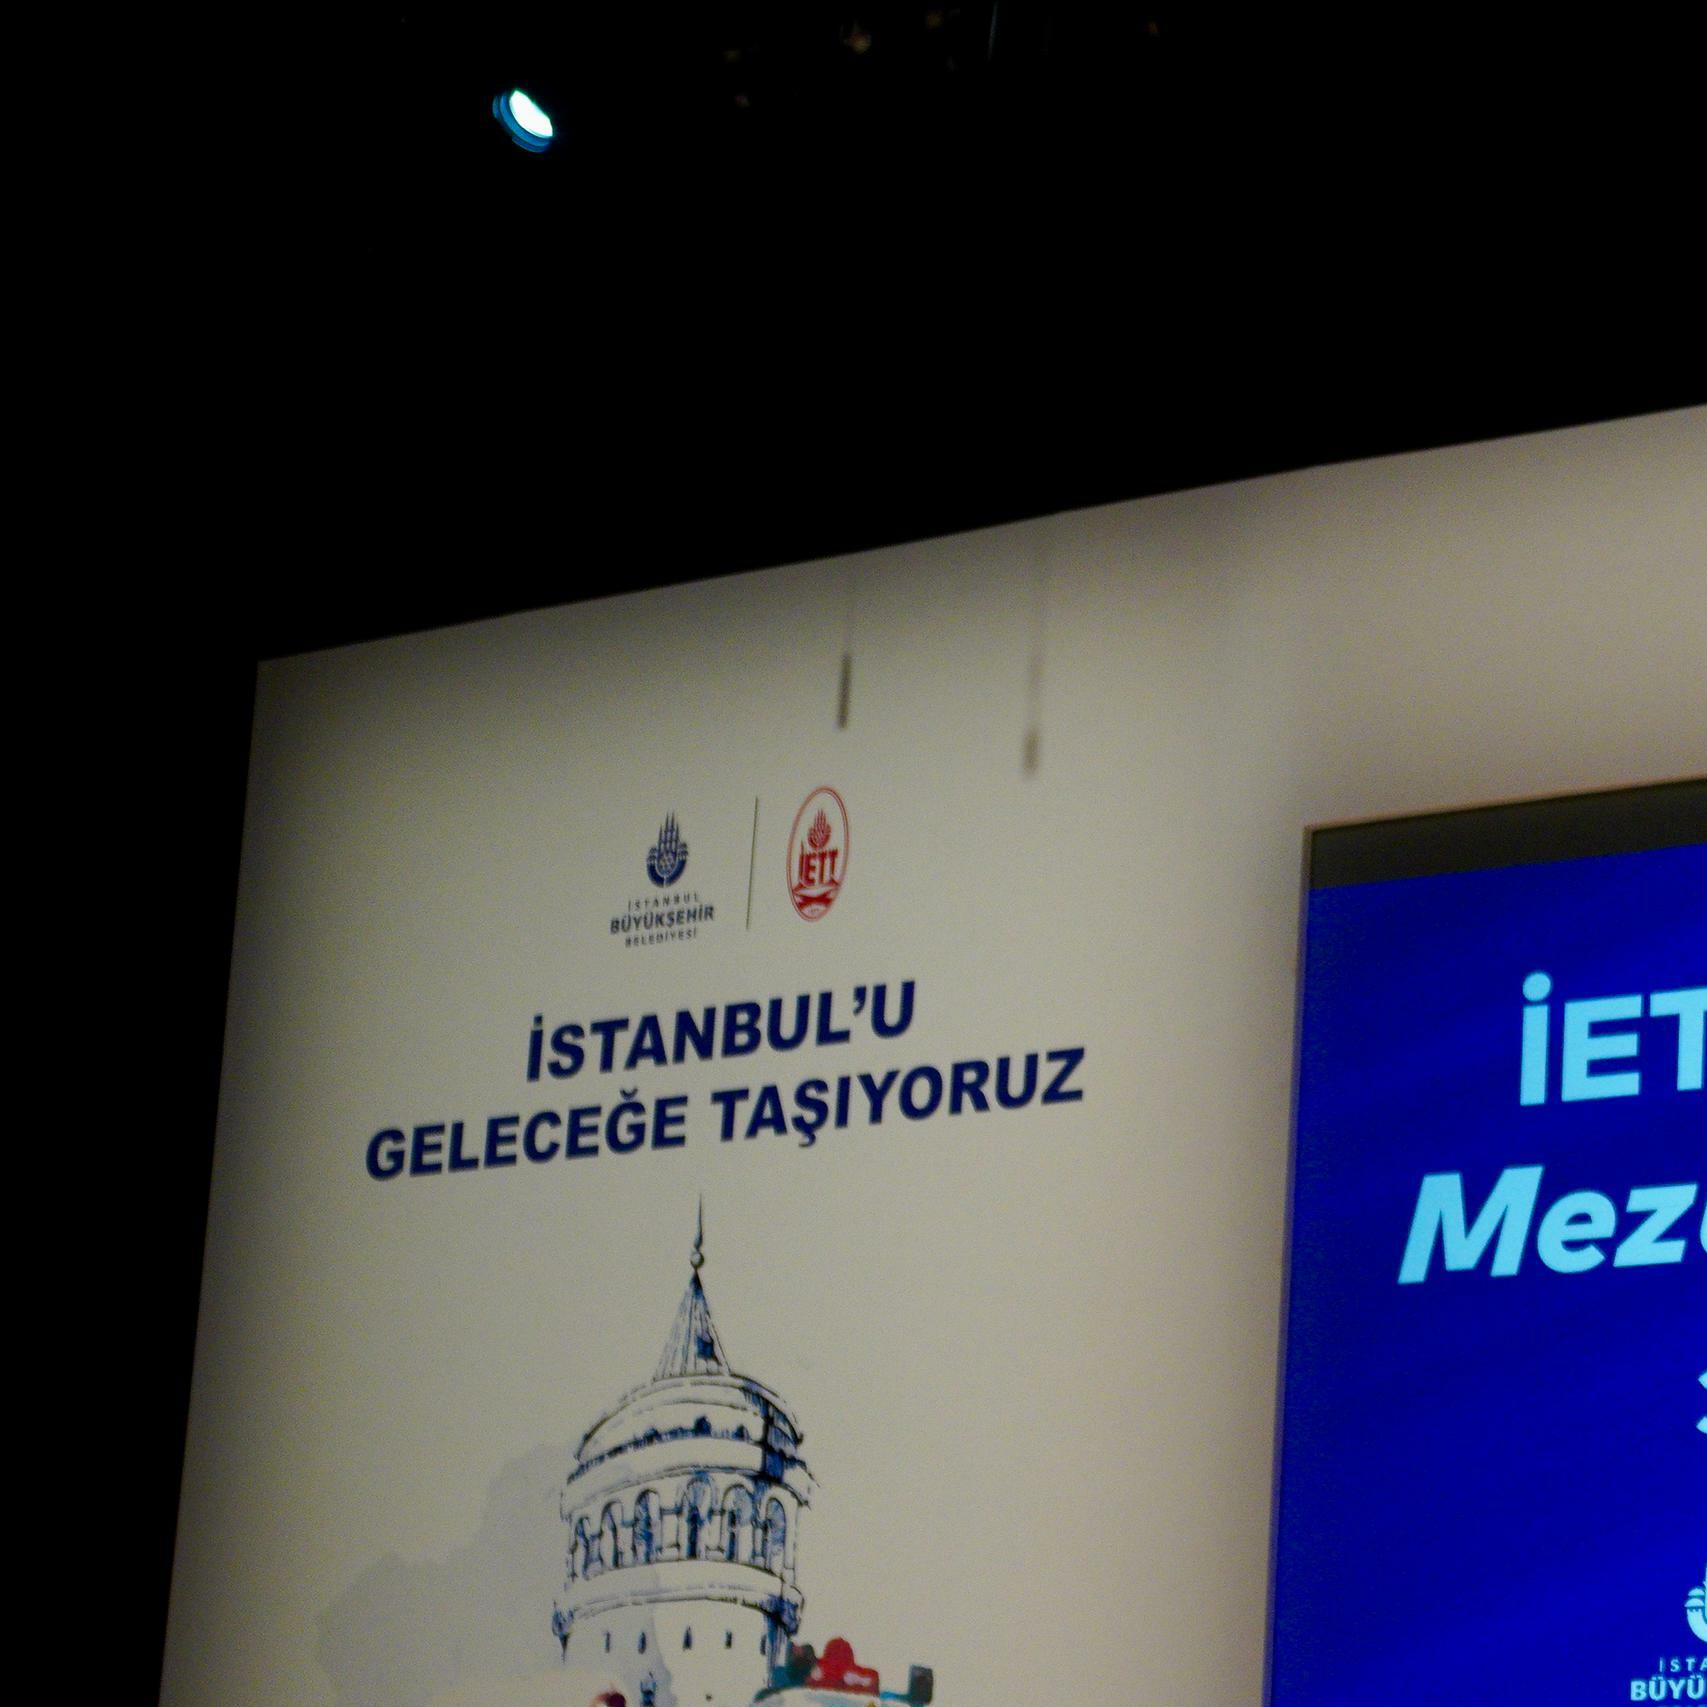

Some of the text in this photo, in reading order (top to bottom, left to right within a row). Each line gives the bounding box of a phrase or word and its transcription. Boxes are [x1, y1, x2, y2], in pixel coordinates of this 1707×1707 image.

[527, 981, 915, 1081] İSTANBUL'U
[366, 1048, 1084, 1181] GELECEĞE TAŞIYORUZ
